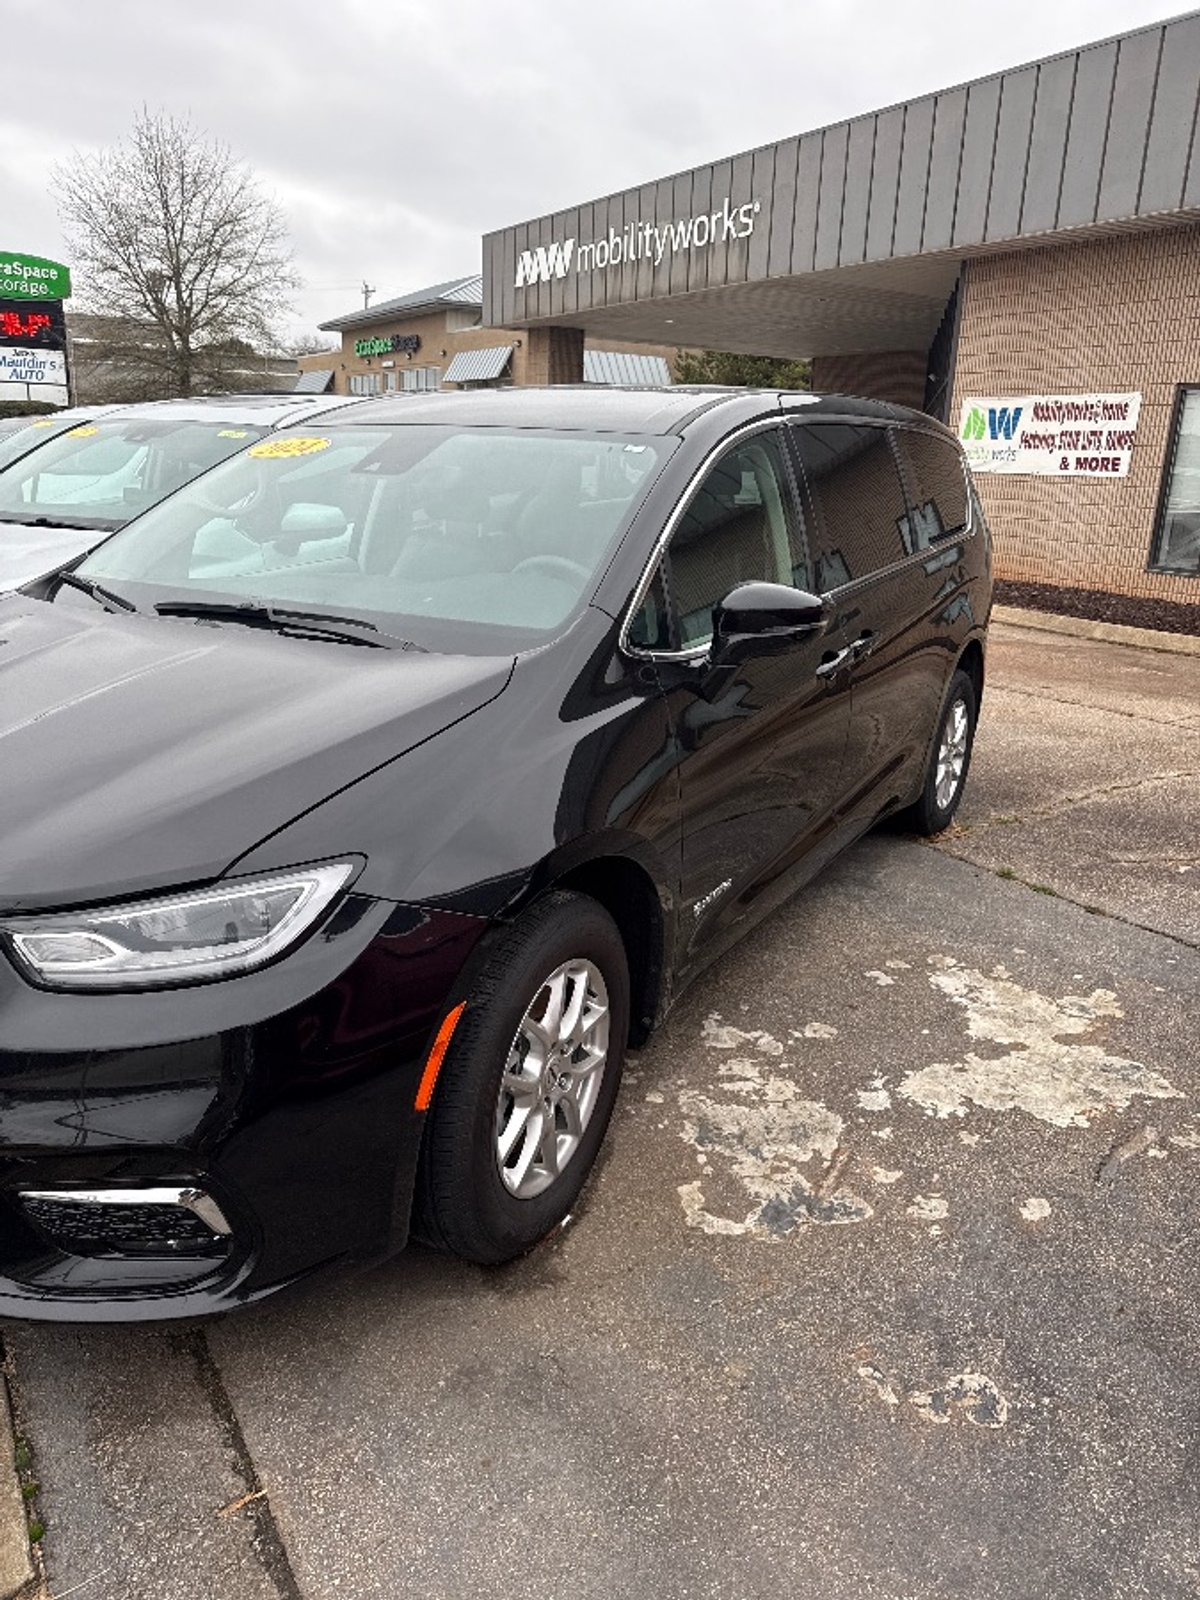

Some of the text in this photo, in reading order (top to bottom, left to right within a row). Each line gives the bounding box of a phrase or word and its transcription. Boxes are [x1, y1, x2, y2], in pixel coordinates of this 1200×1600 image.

[9, 368, 45, 381] AUTO
[1059, 456, 1121, 472] & MORE
